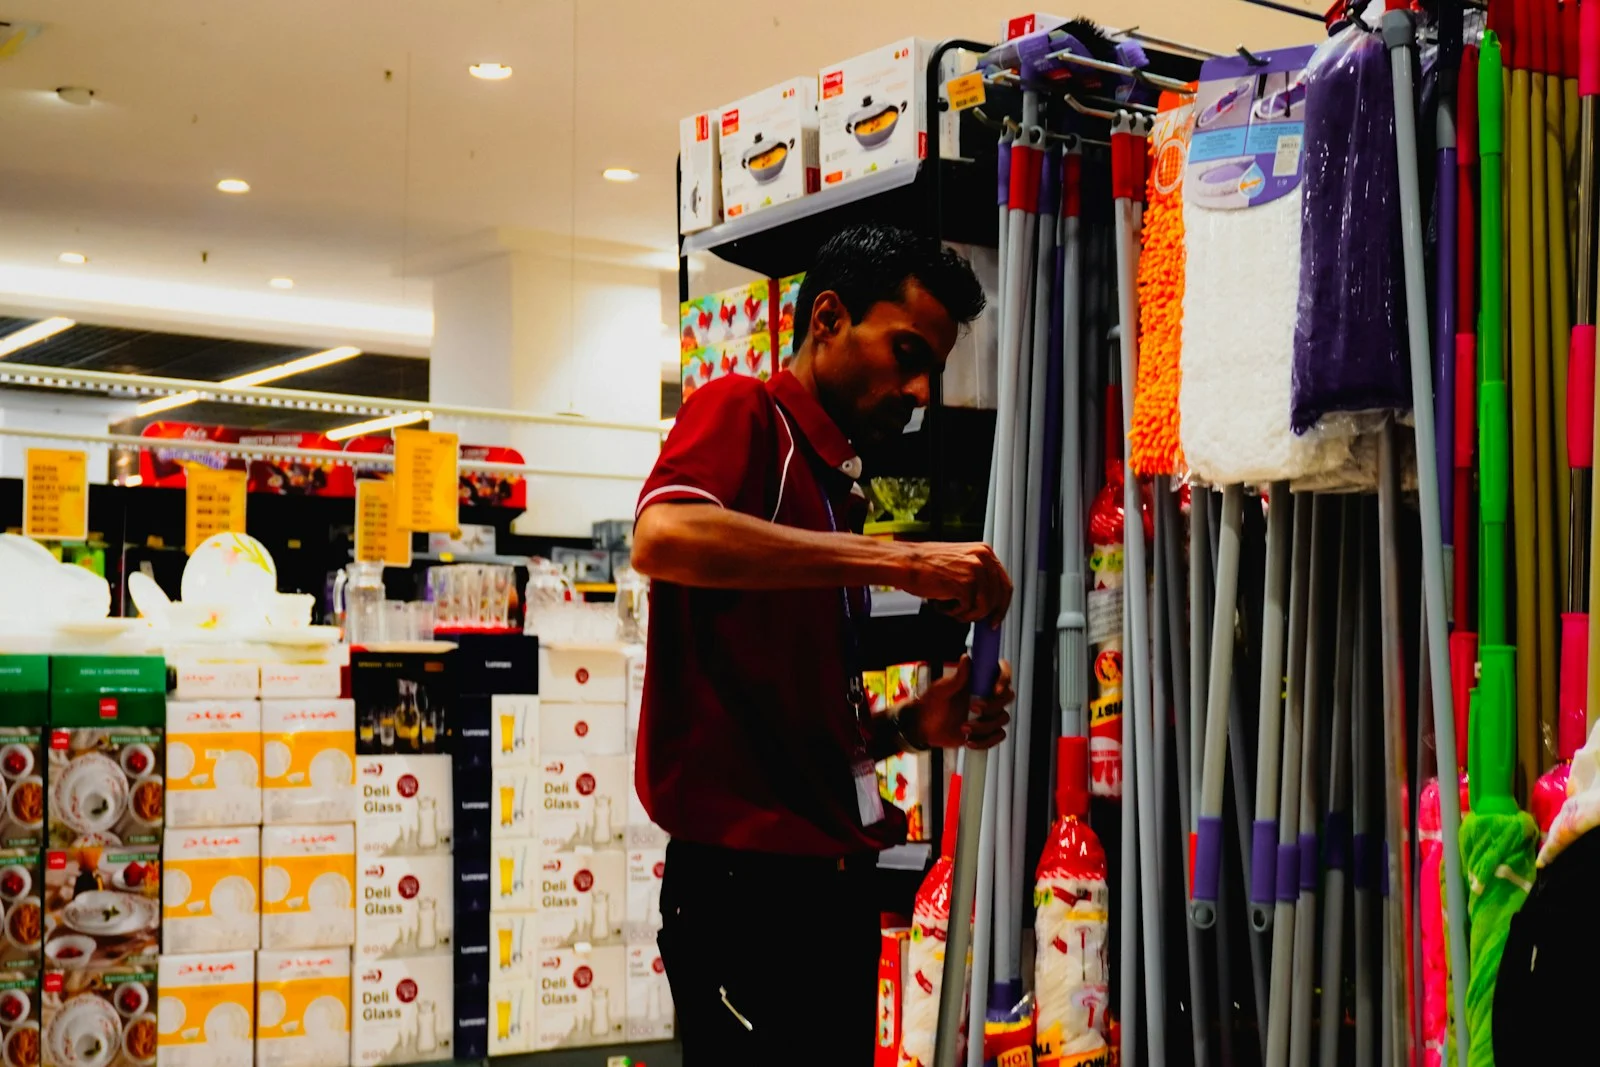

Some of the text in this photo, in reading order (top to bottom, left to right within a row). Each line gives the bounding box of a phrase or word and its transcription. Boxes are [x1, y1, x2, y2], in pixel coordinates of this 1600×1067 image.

[363, 784, 390, 798] Deli
[544, 782, 569, 795] Deli
[363, 800, 402, 813] Glass
[543, 797, 580, 810] Glass
[364, 886, 391, 900] Deli
[542, 880, 567, 893] Deli
[542, 896, 578, 909] Glass
[364, 903, 403, 916] Glass
[541, 977, 567, 990] Deli
[362, 991, 389, 1005] Deli
[541, 993, 577, 1006] Glass
[362, 1008, 401, 1022] Glass
[1001, 1051, 1029, 1067] HOT
